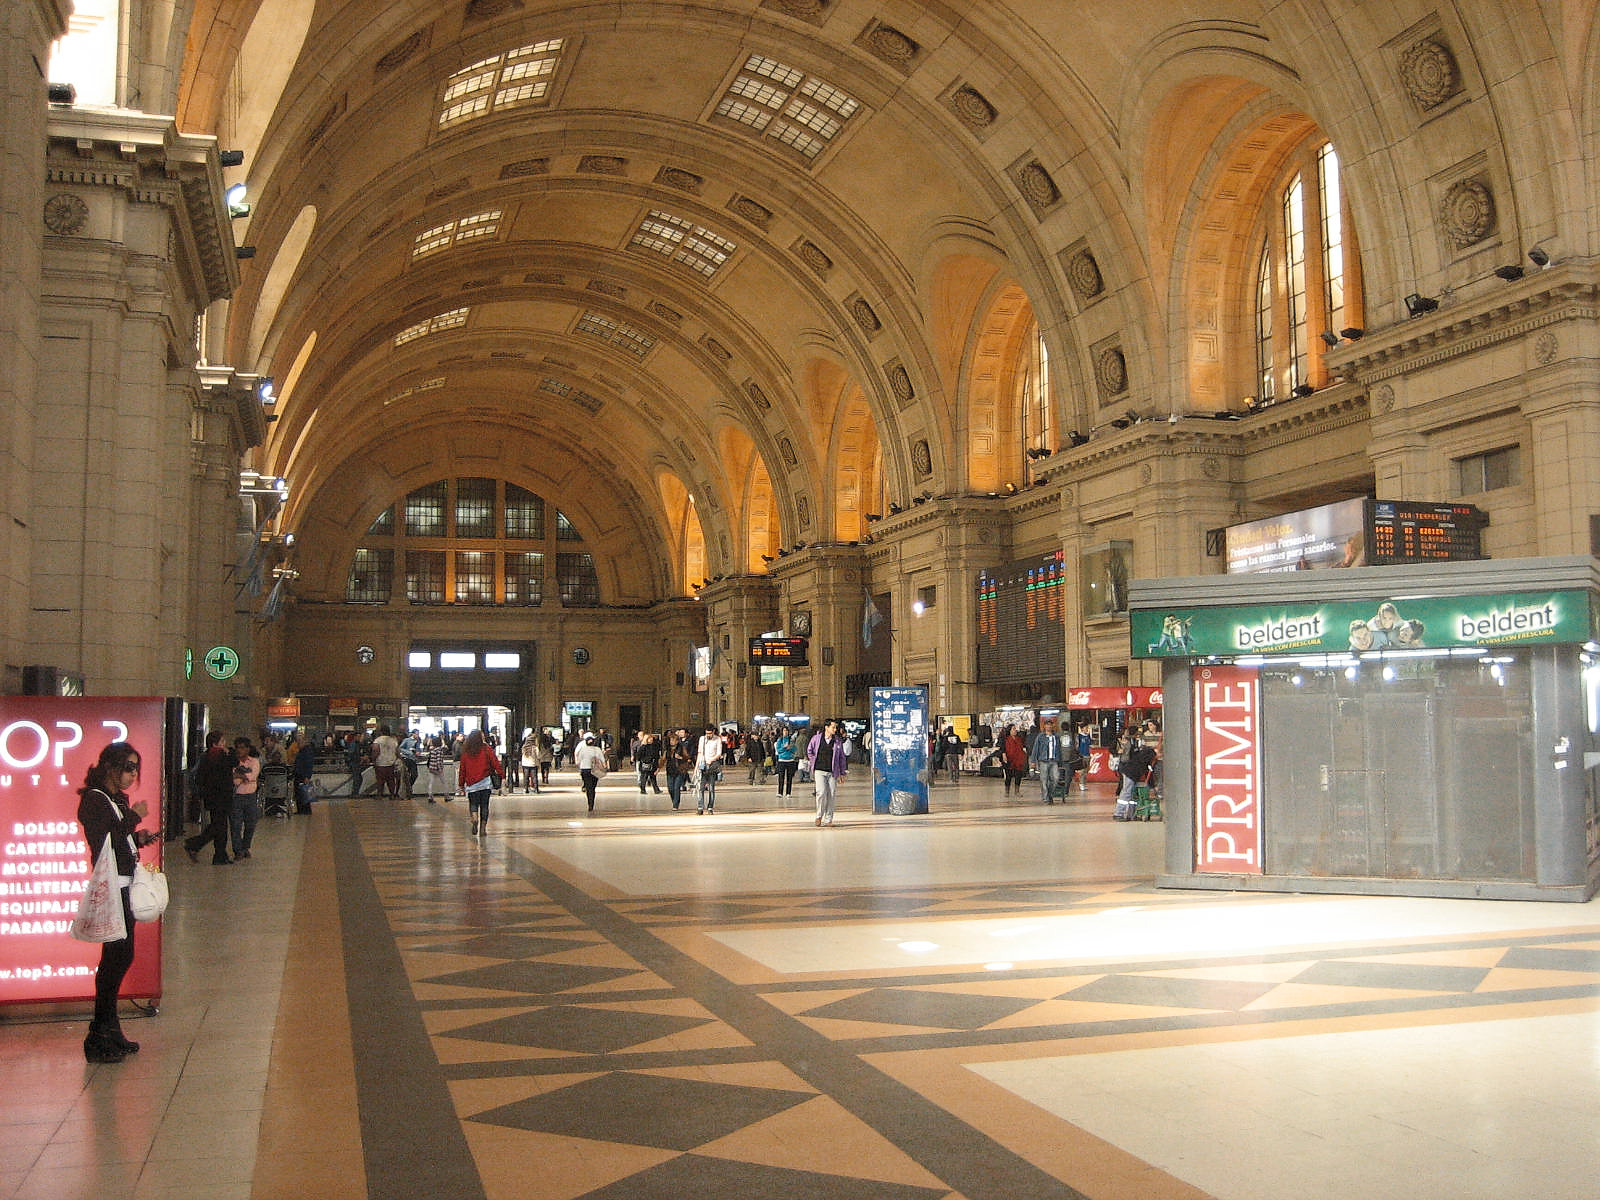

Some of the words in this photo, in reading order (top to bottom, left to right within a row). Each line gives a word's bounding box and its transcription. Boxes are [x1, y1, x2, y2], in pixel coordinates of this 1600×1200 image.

[1461, 605, 1553, 637] beldent
[1239, 616, 1320, 646] beldent
[1517, 628, 1555, 640] FRESCURA
[1288, 638, 1321, 648] FRESCURA
[1203, 682, 1253, 865] PRIME
[13, 822, 78, 836] BOLSOS
[5, 841, 86, 856] CARTERAS
[2, 861, 88, 875] MOCHILAS
[0, 964, 100, 981] w.top3.com.
